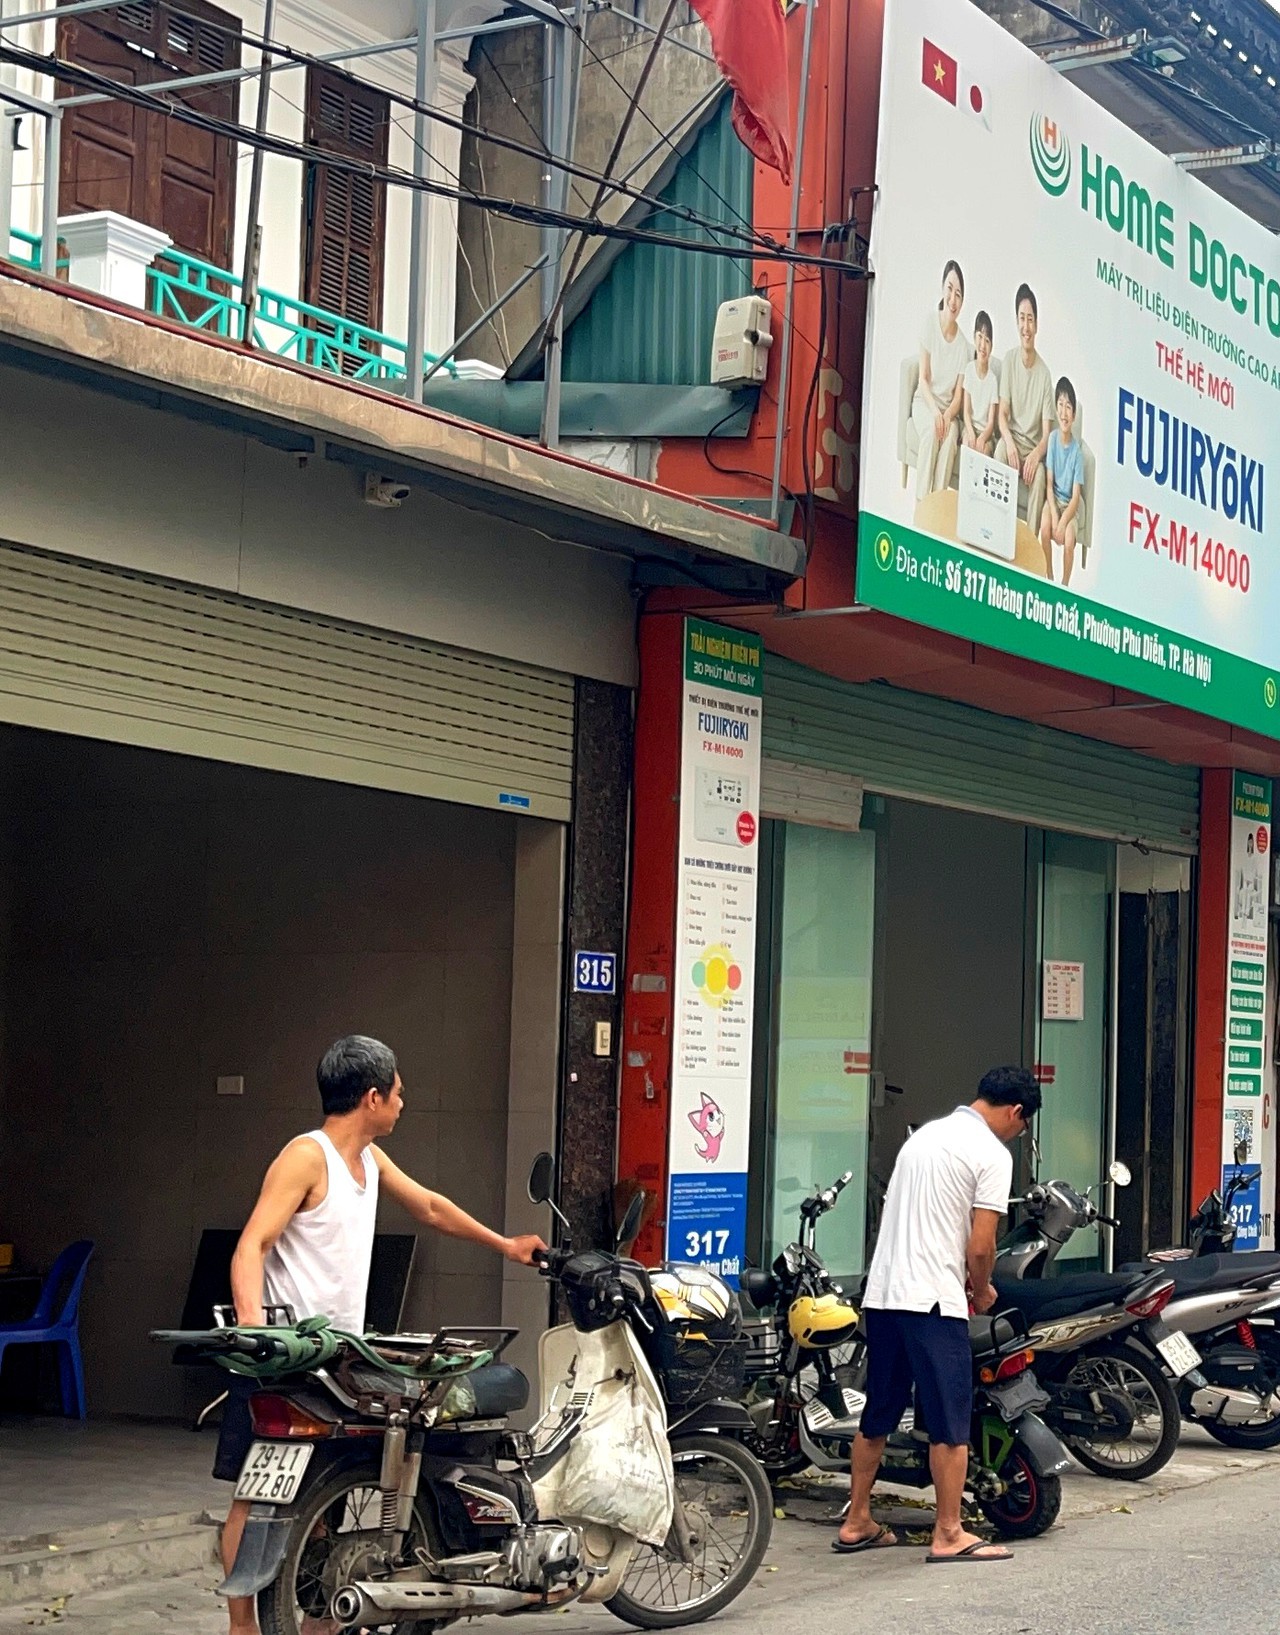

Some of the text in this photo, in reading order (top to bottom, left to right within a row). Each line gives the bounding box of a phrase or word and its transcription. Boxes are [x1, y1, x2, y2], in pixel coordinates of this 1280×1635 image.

[1081, 143, 1174, 270] HOME
[1096, 258, 1123, 291] MÁY
[1125, 276, 1143, 311] TRỊ
[1145, 290, 1170, 322] LIỆU
[1172, 308, 1199, 340] ĐIỆN
[1200, 324, 1246, 369] TRƯỜNG
[1248, 355, 1269, 383] CAO
[1155, 341, 1234, 410] THẾ HỆ MỚI
[1128, 502, 1251, 594] FX-M14000
[895, 545, 1212, 687] Địa chỉ: Số 317 Hoàng Công Chất, Phường Phú Diễn, TP. Hà Nội
[704, 663, 723, 681] PHÚT
[737, 668, 756, 688] NGÀY
[579, 958, 612, 986] 315
[1231, 1204, 1253, 1224] 317
[685, 1229, 730, 1257] 317
[721, 1255, 740, 1277] Chất
[252, 1445, 302, 1471] 29-L1
[237, 1472, 296, 1499] 272.80
